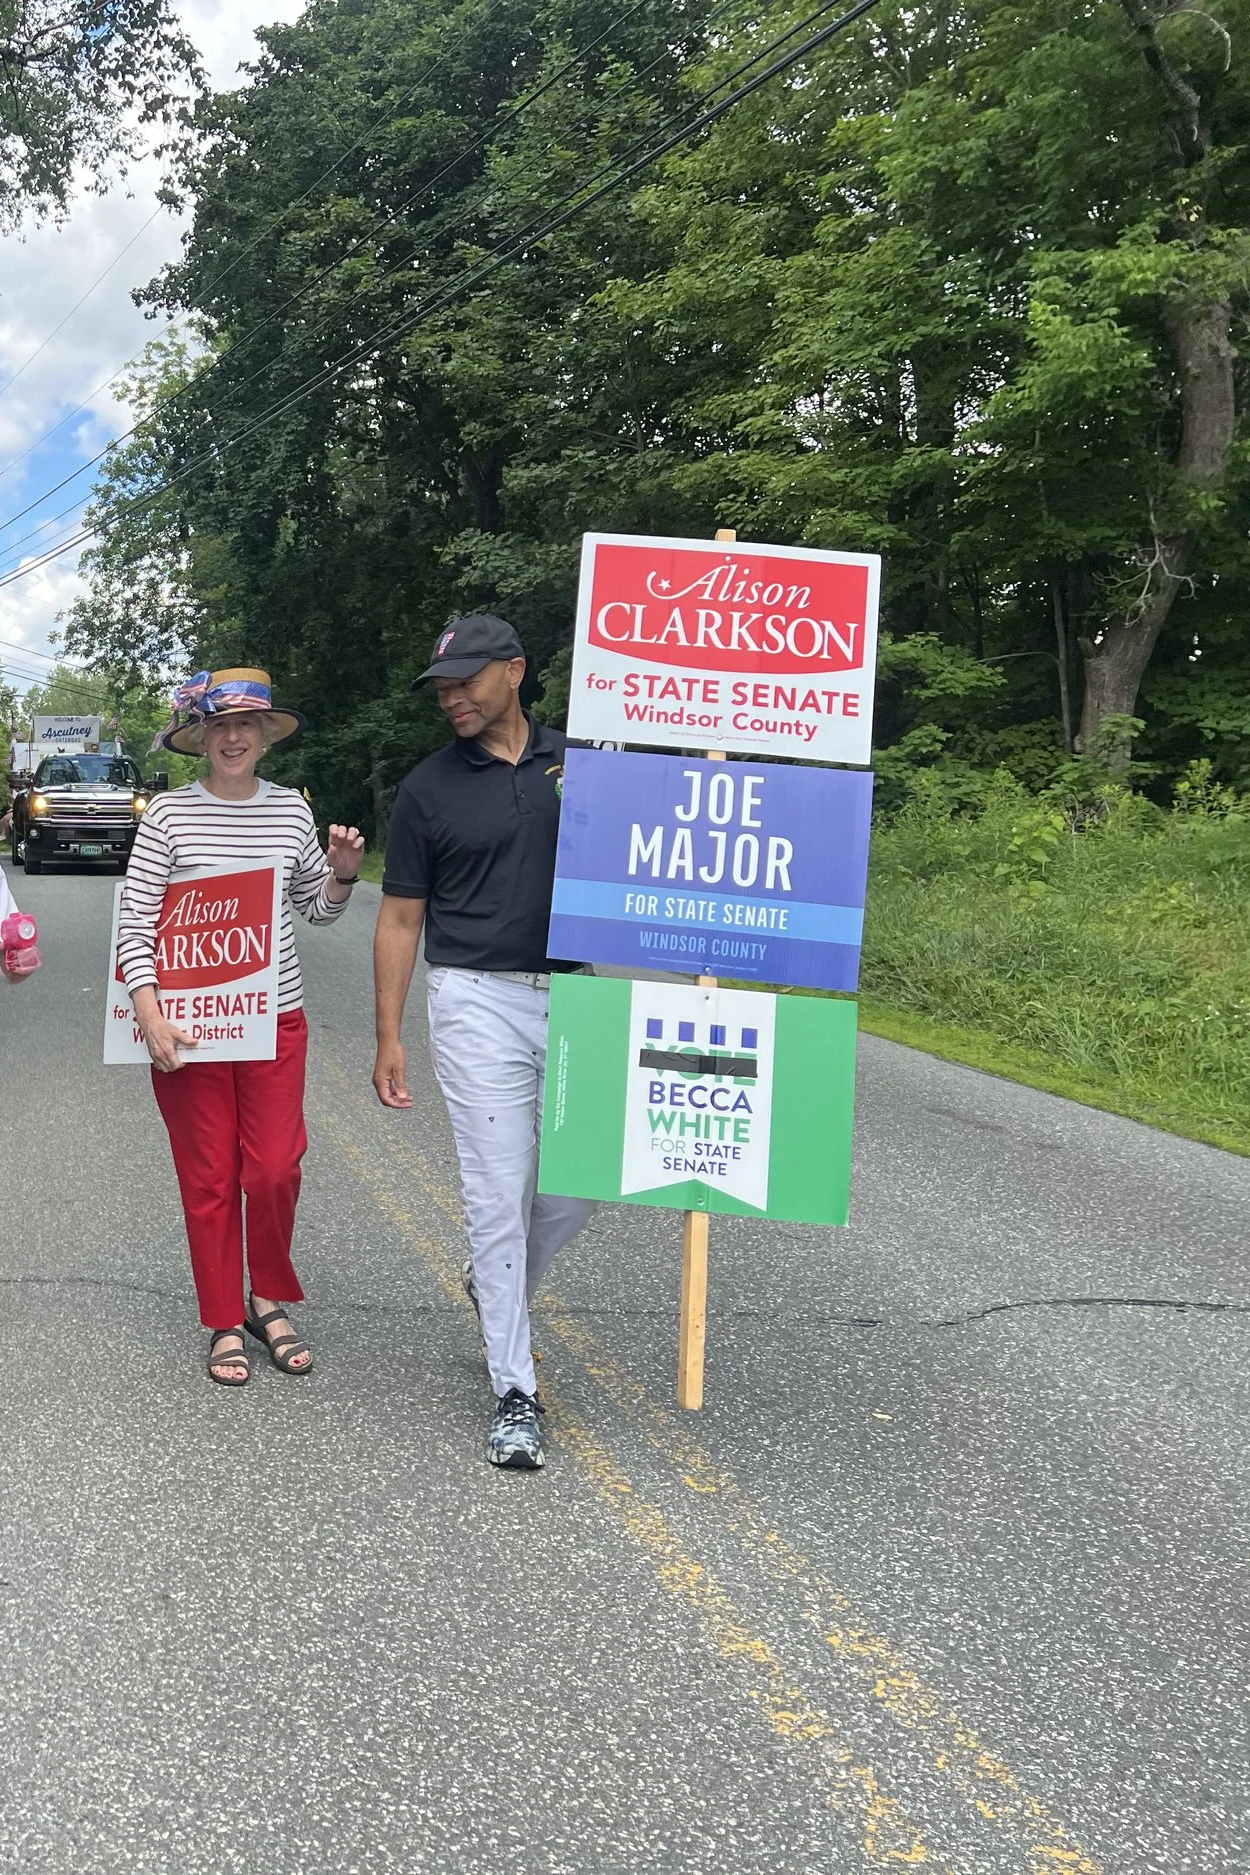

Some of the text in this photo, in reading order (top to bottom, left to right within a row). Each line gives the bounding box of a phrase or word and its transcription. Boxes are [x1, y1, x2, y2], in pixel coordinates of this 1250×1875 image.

[647, 555, 811, 609] Alison
[596, 601, 859, 662] CLARKSON
[586, 672, 860, 718] for STATE SENATE
[624, 702, 723, 729] Windsor
[732, 712, 818, 742] County
[674, 769, 766, 829] JOE
[627, 822, 794, 892] MAJOR
[157, 889, 240, 932] Alison
[625, 892, 789, 930] FOR STATE SENATE
[155, 924, 269, 972] ARKSON
[639, 930, 767, 961] WINDSOR COUNTY
[113, 1005, 130, 1019] for
[192, 991, 268, 1019] SENATE
[192, 1023, 244, 1041] District
[648, 1080, 753, 1114] BECCA
[646, 1108, 751, 1143] WHITE
[650, 1137, 742, 1160] FOR STATE
[662, 1156, 728, 1176] SENATE
